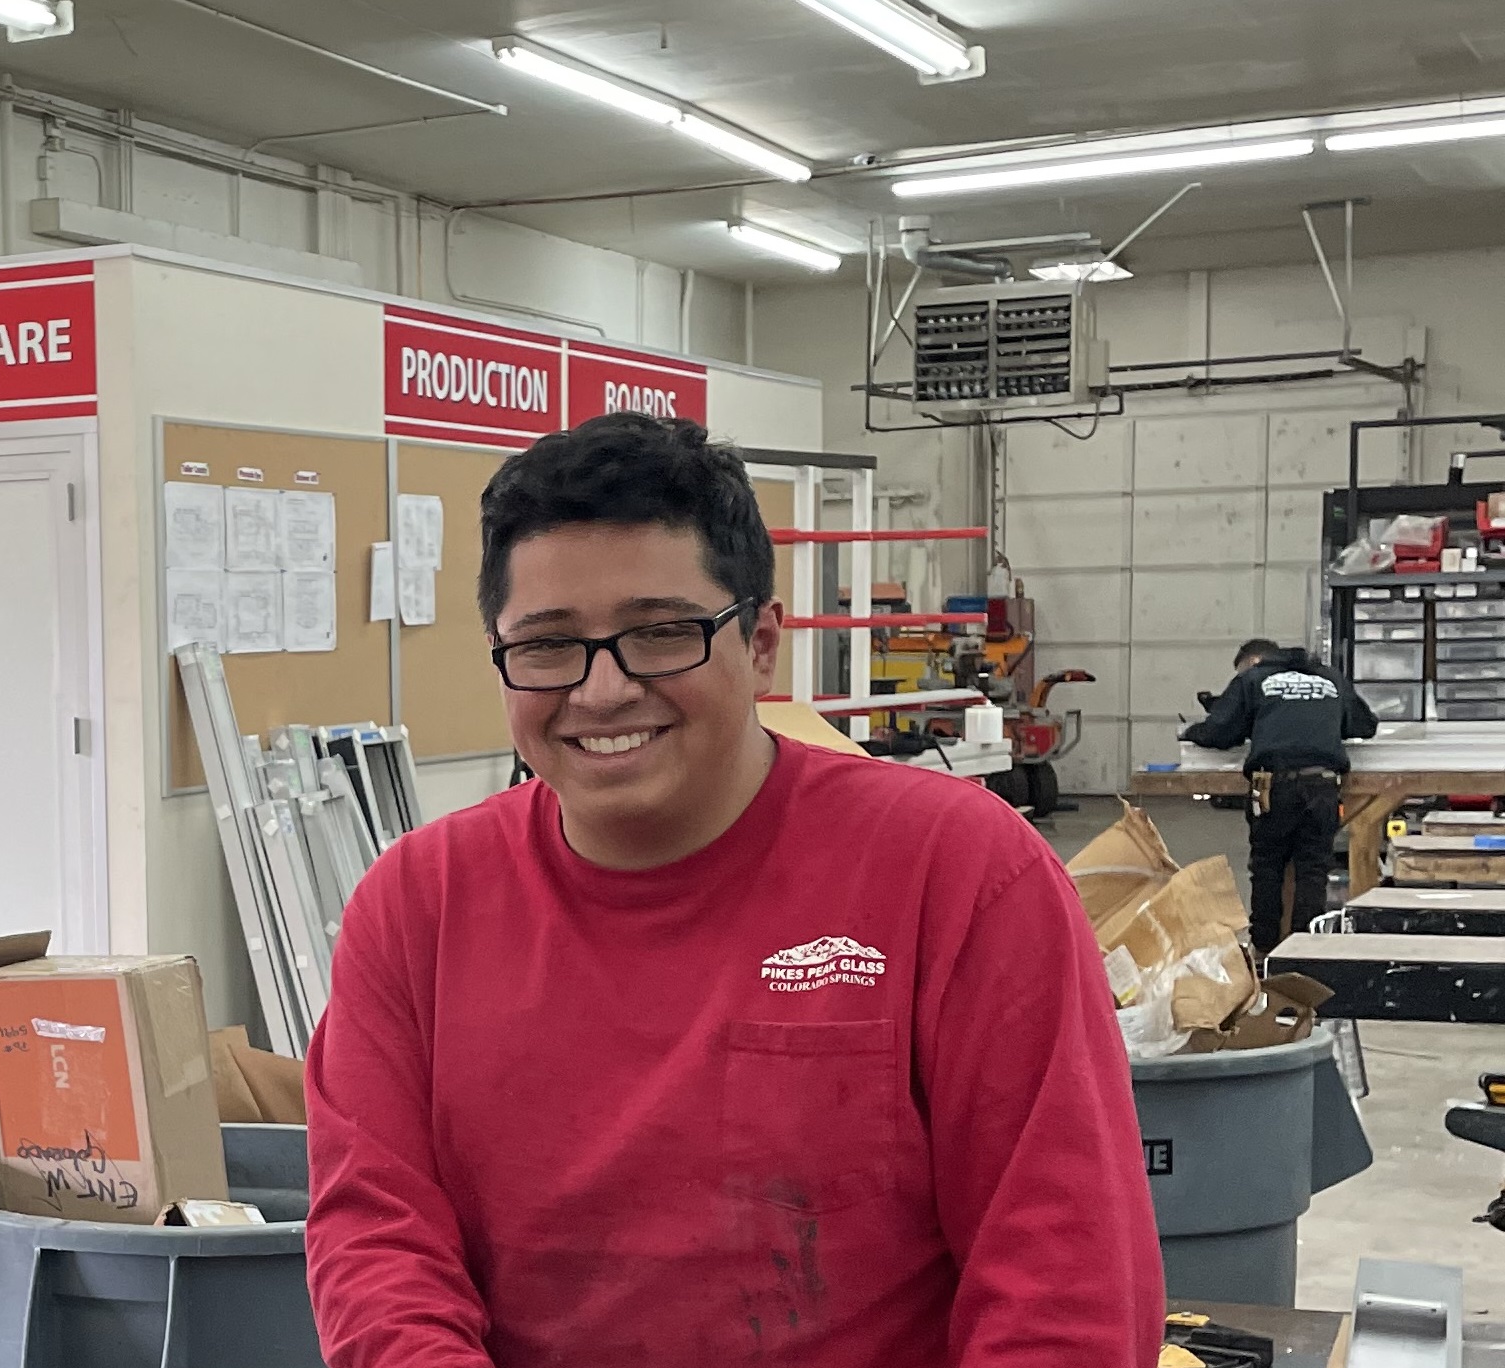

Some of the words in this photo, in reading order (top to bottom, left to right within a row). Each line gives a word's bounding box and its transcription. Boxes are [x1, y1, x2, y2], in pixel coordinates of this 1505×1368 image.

[401, 346, 548, 414] PRODUCTION
[604, 380, 677, 419] BOARDS
[761, 967, 804, 980] PIKES
[807, 960, 837, 979] PEAK
[839, 959, 886, 975] GLASS
[769, 976, 829, 992] COLORADO
[829, 973, 876, 987] SPRINGS
[49, 1044, 71, 1089] LCN
